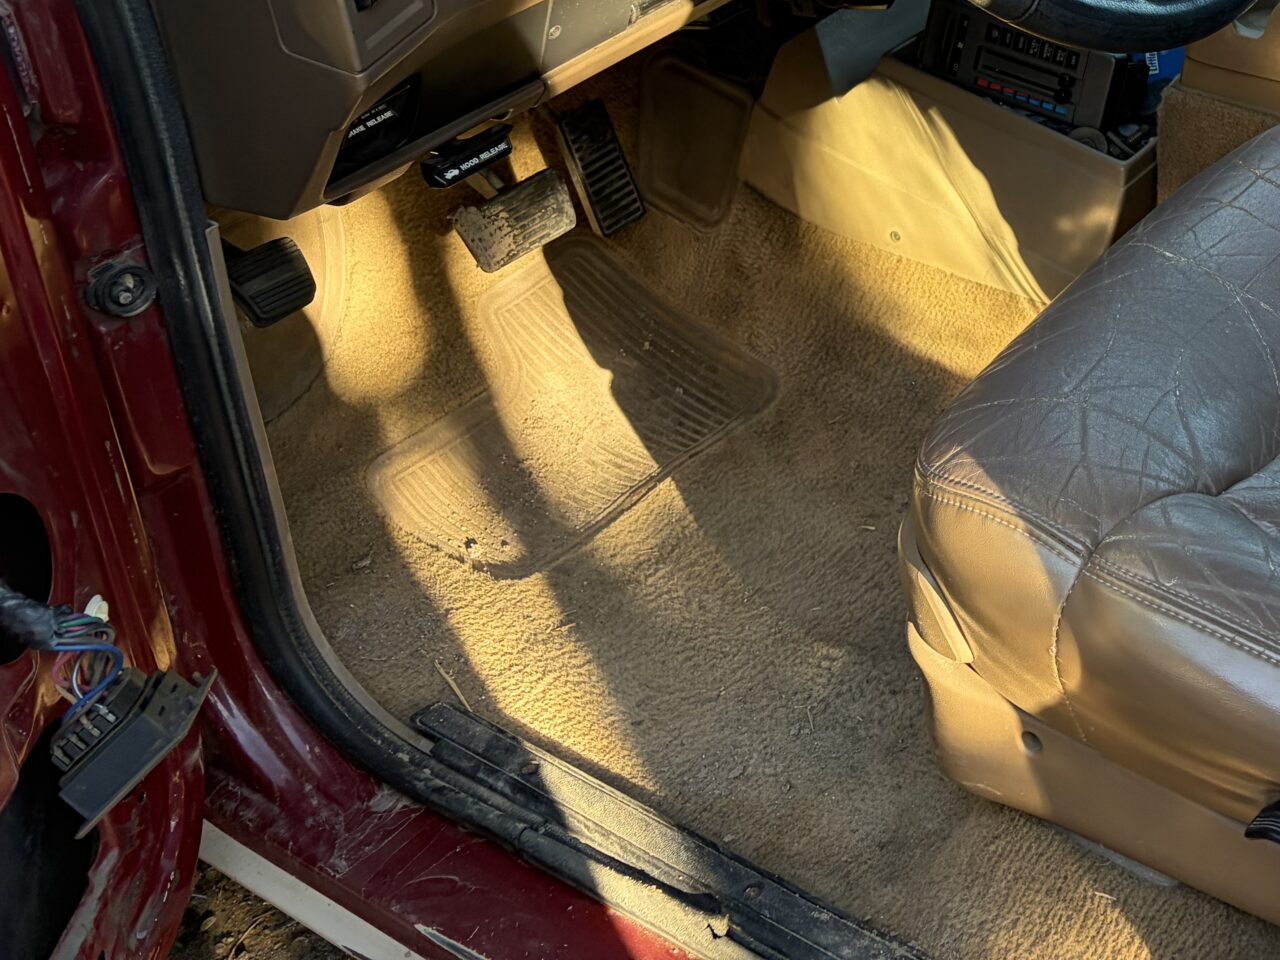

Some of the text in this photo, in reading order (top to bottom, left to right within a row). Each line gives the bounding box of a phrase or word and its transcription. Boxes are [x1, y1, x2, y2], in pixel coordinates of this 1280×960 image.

[366, 110, 394, 127] RELEASE
[460, 142, 508, 171] HOOD RELEASE
